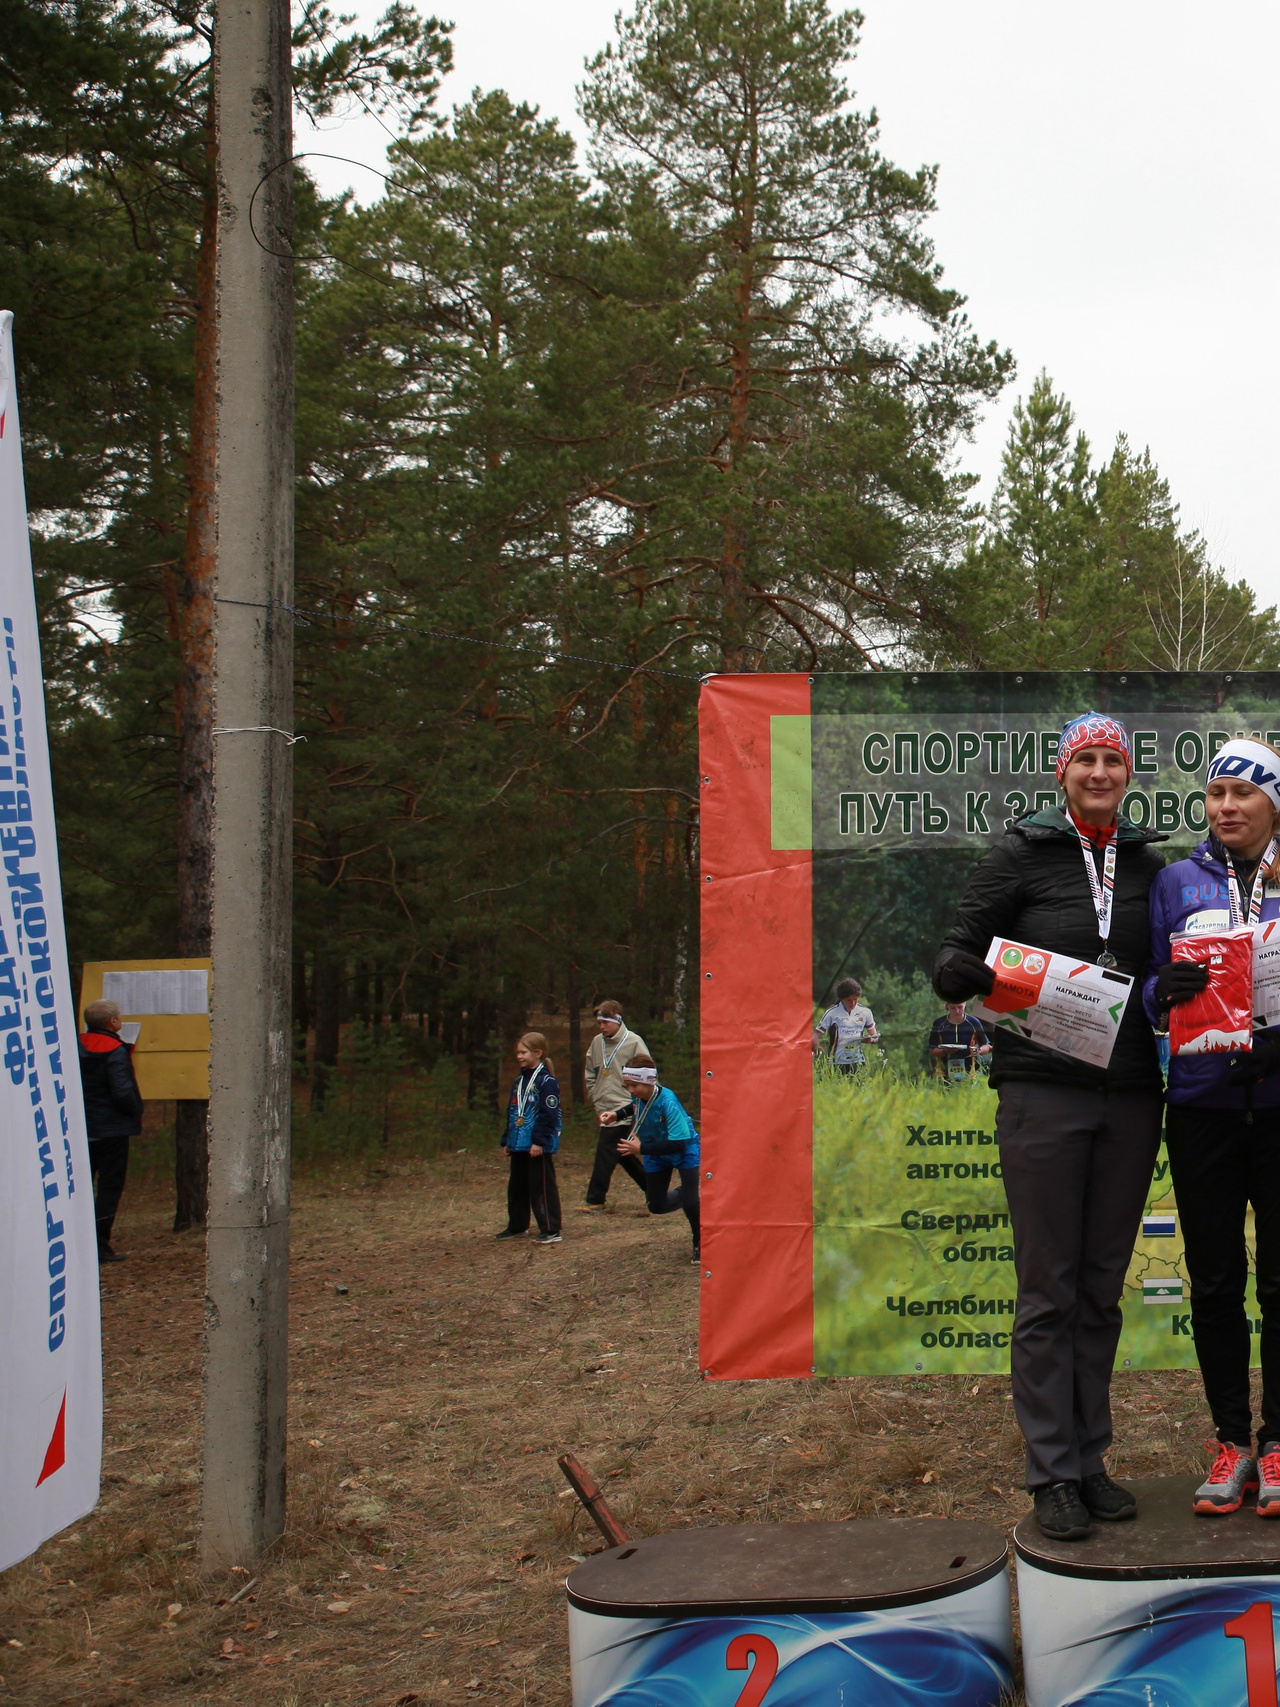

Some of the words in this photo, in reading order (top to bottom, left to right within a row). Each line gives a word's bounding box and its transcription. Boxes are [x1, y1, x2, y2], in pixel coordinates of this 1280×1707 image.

[839, 791, 949, 835] ПУТЬ
[966, 791, 990, 834] К
[1055, 986, 1100, 1004] НАГРАЖДАЕТ
[726, 1633, 780, 1707] 2
[1224, 1602, 1278, 1707] 1
